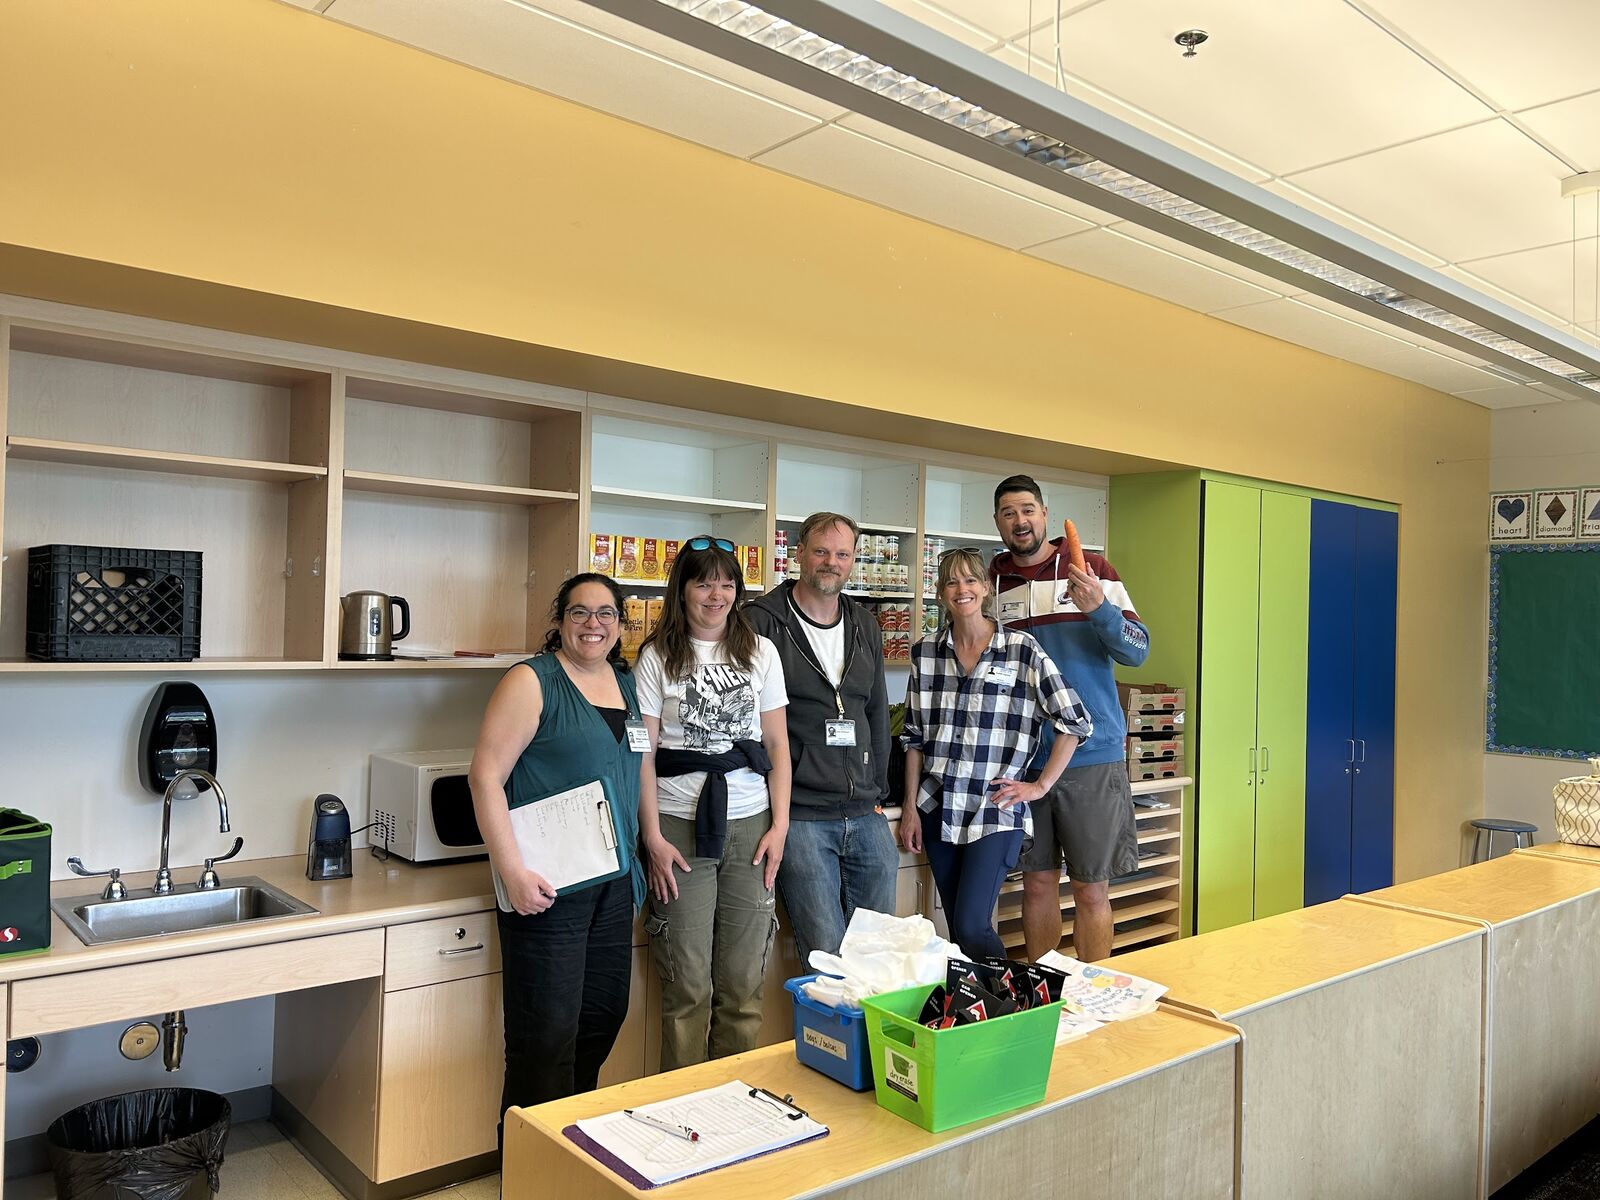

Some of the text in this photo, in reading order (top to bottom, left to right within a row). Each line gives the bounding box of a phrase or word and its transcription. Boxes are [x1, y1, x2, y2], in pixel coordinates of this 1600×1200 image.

[1498, 526, 1522, 535] heart
[1540, 525, 1572, 533] diamond
[960, 989, 976, 999] OPENER
[889, 1070, 899, 1080] dry
